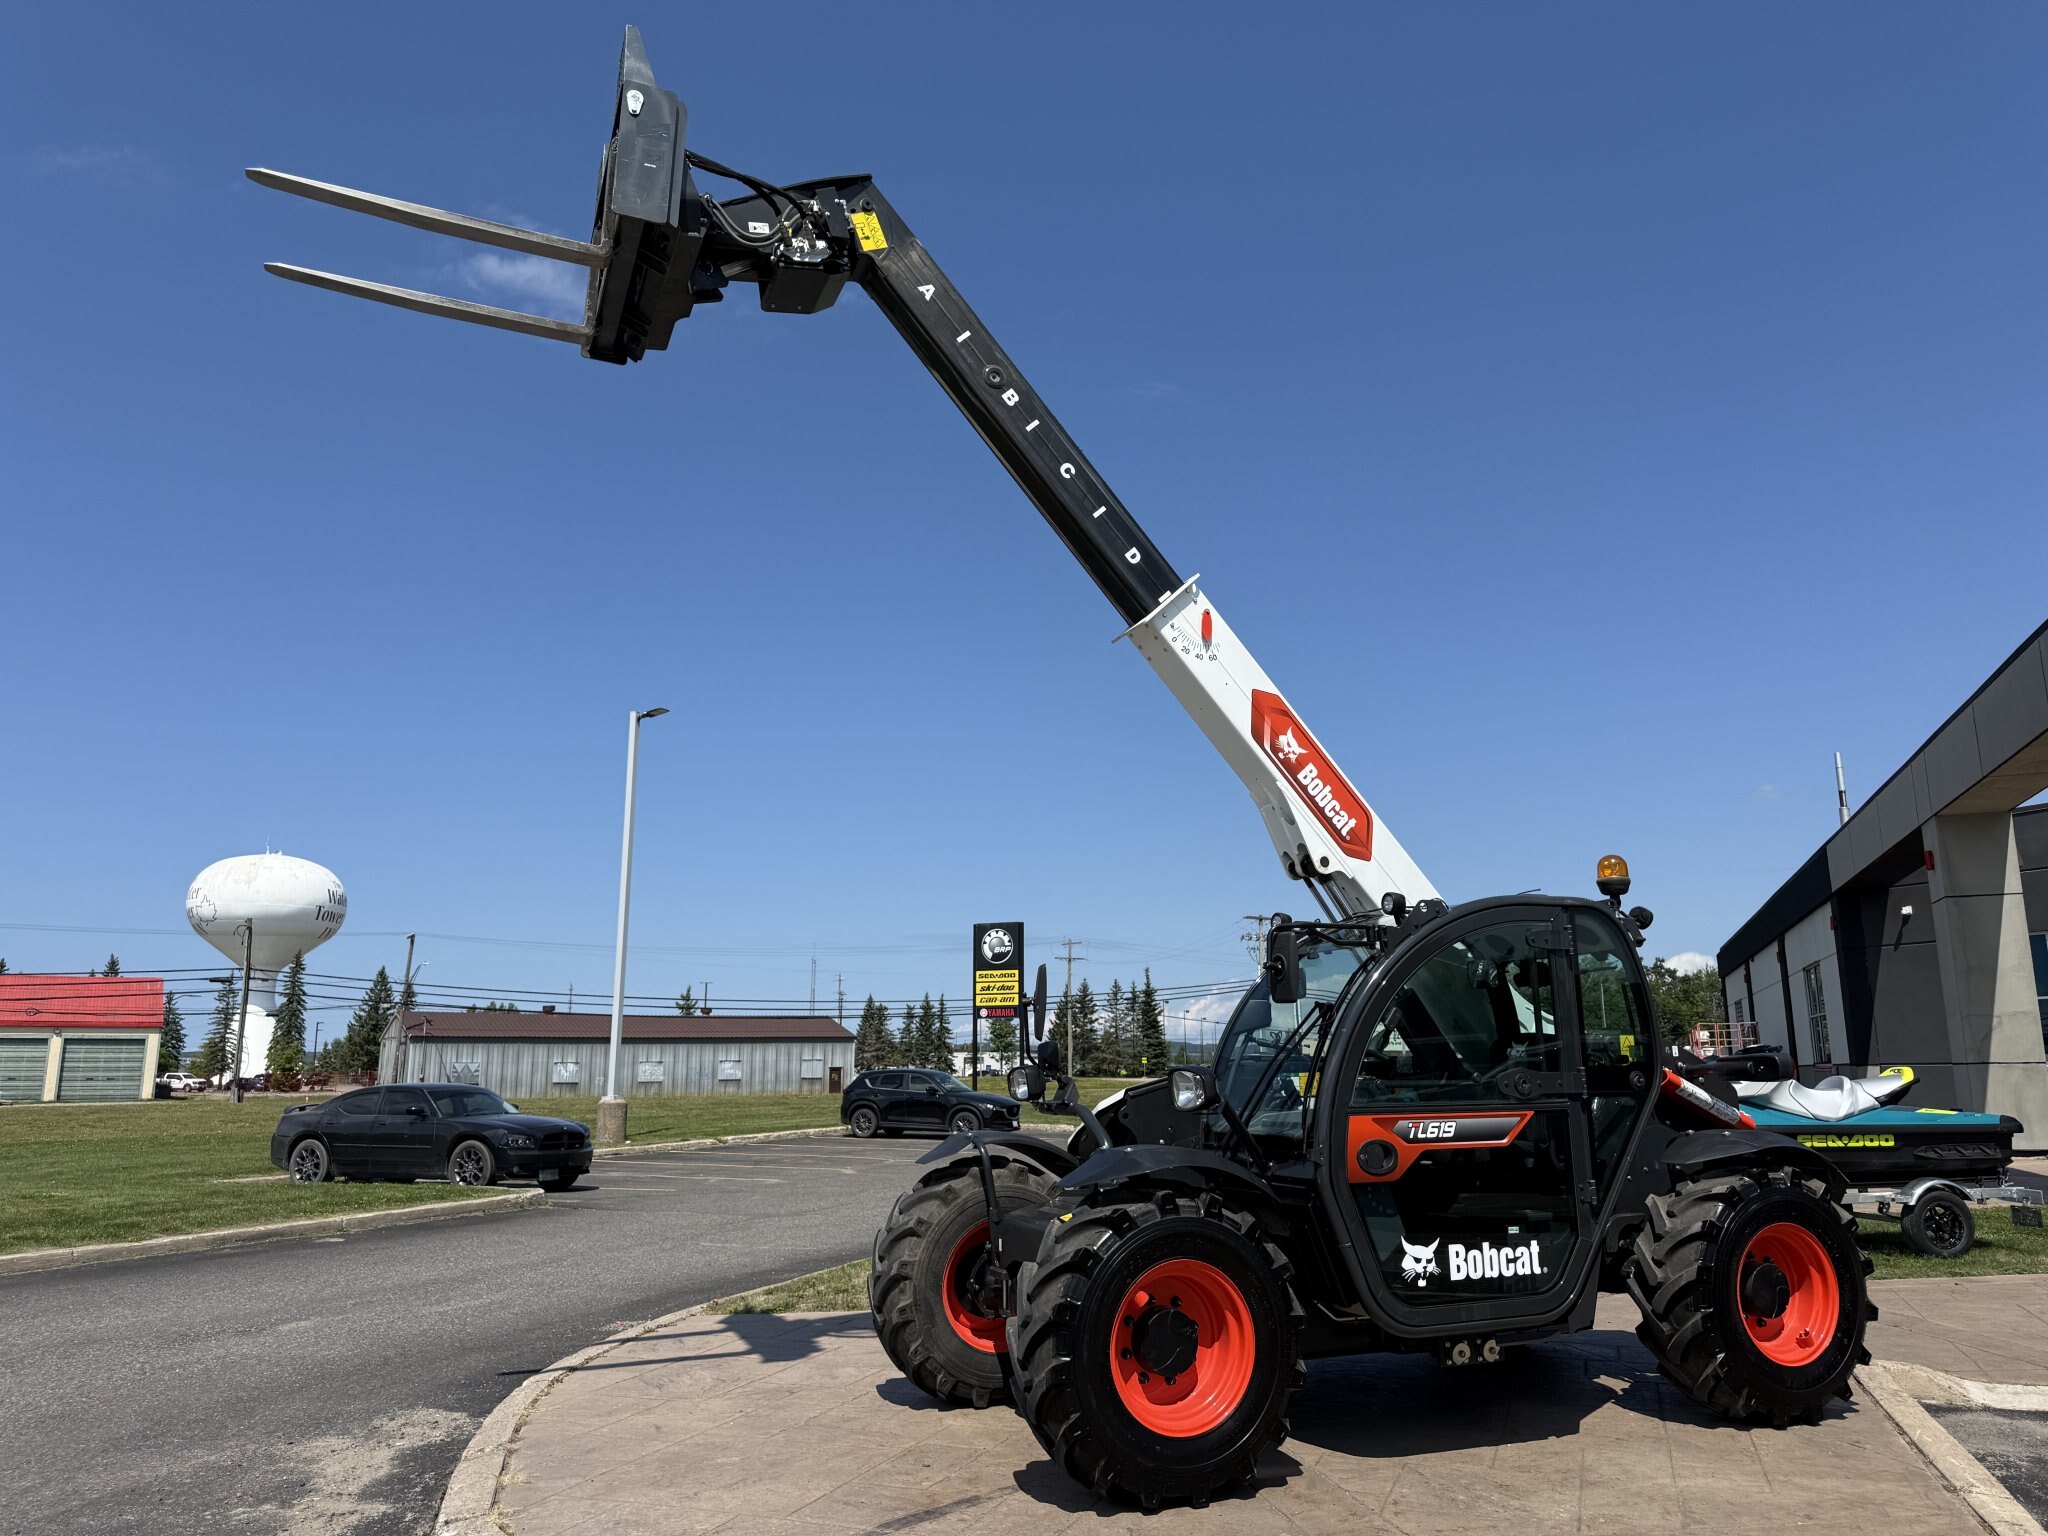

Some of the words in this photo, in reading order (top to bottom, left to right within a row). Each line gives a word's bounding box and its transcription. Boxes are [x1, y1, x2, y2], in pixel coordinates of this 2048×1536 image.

[917, 283, 935, 301] A
[1001, 388, 1020, 407] B
[1059, 462, 1076, 480] C
[1124, 547, 1142, 565] D
[1181, 646, 1190, 654] 20
[1297, 763, 1356, 836] Bobcat
[979, 983, 1015, 992] ski-doo
[979, 996, 1015, 1004] can-am
[987, 1008, 1015, 1017] YAMAHA
[1408, 1121, 1457, 1139] TL619
[1448, 1239, 1542, 1281] Bobcat
